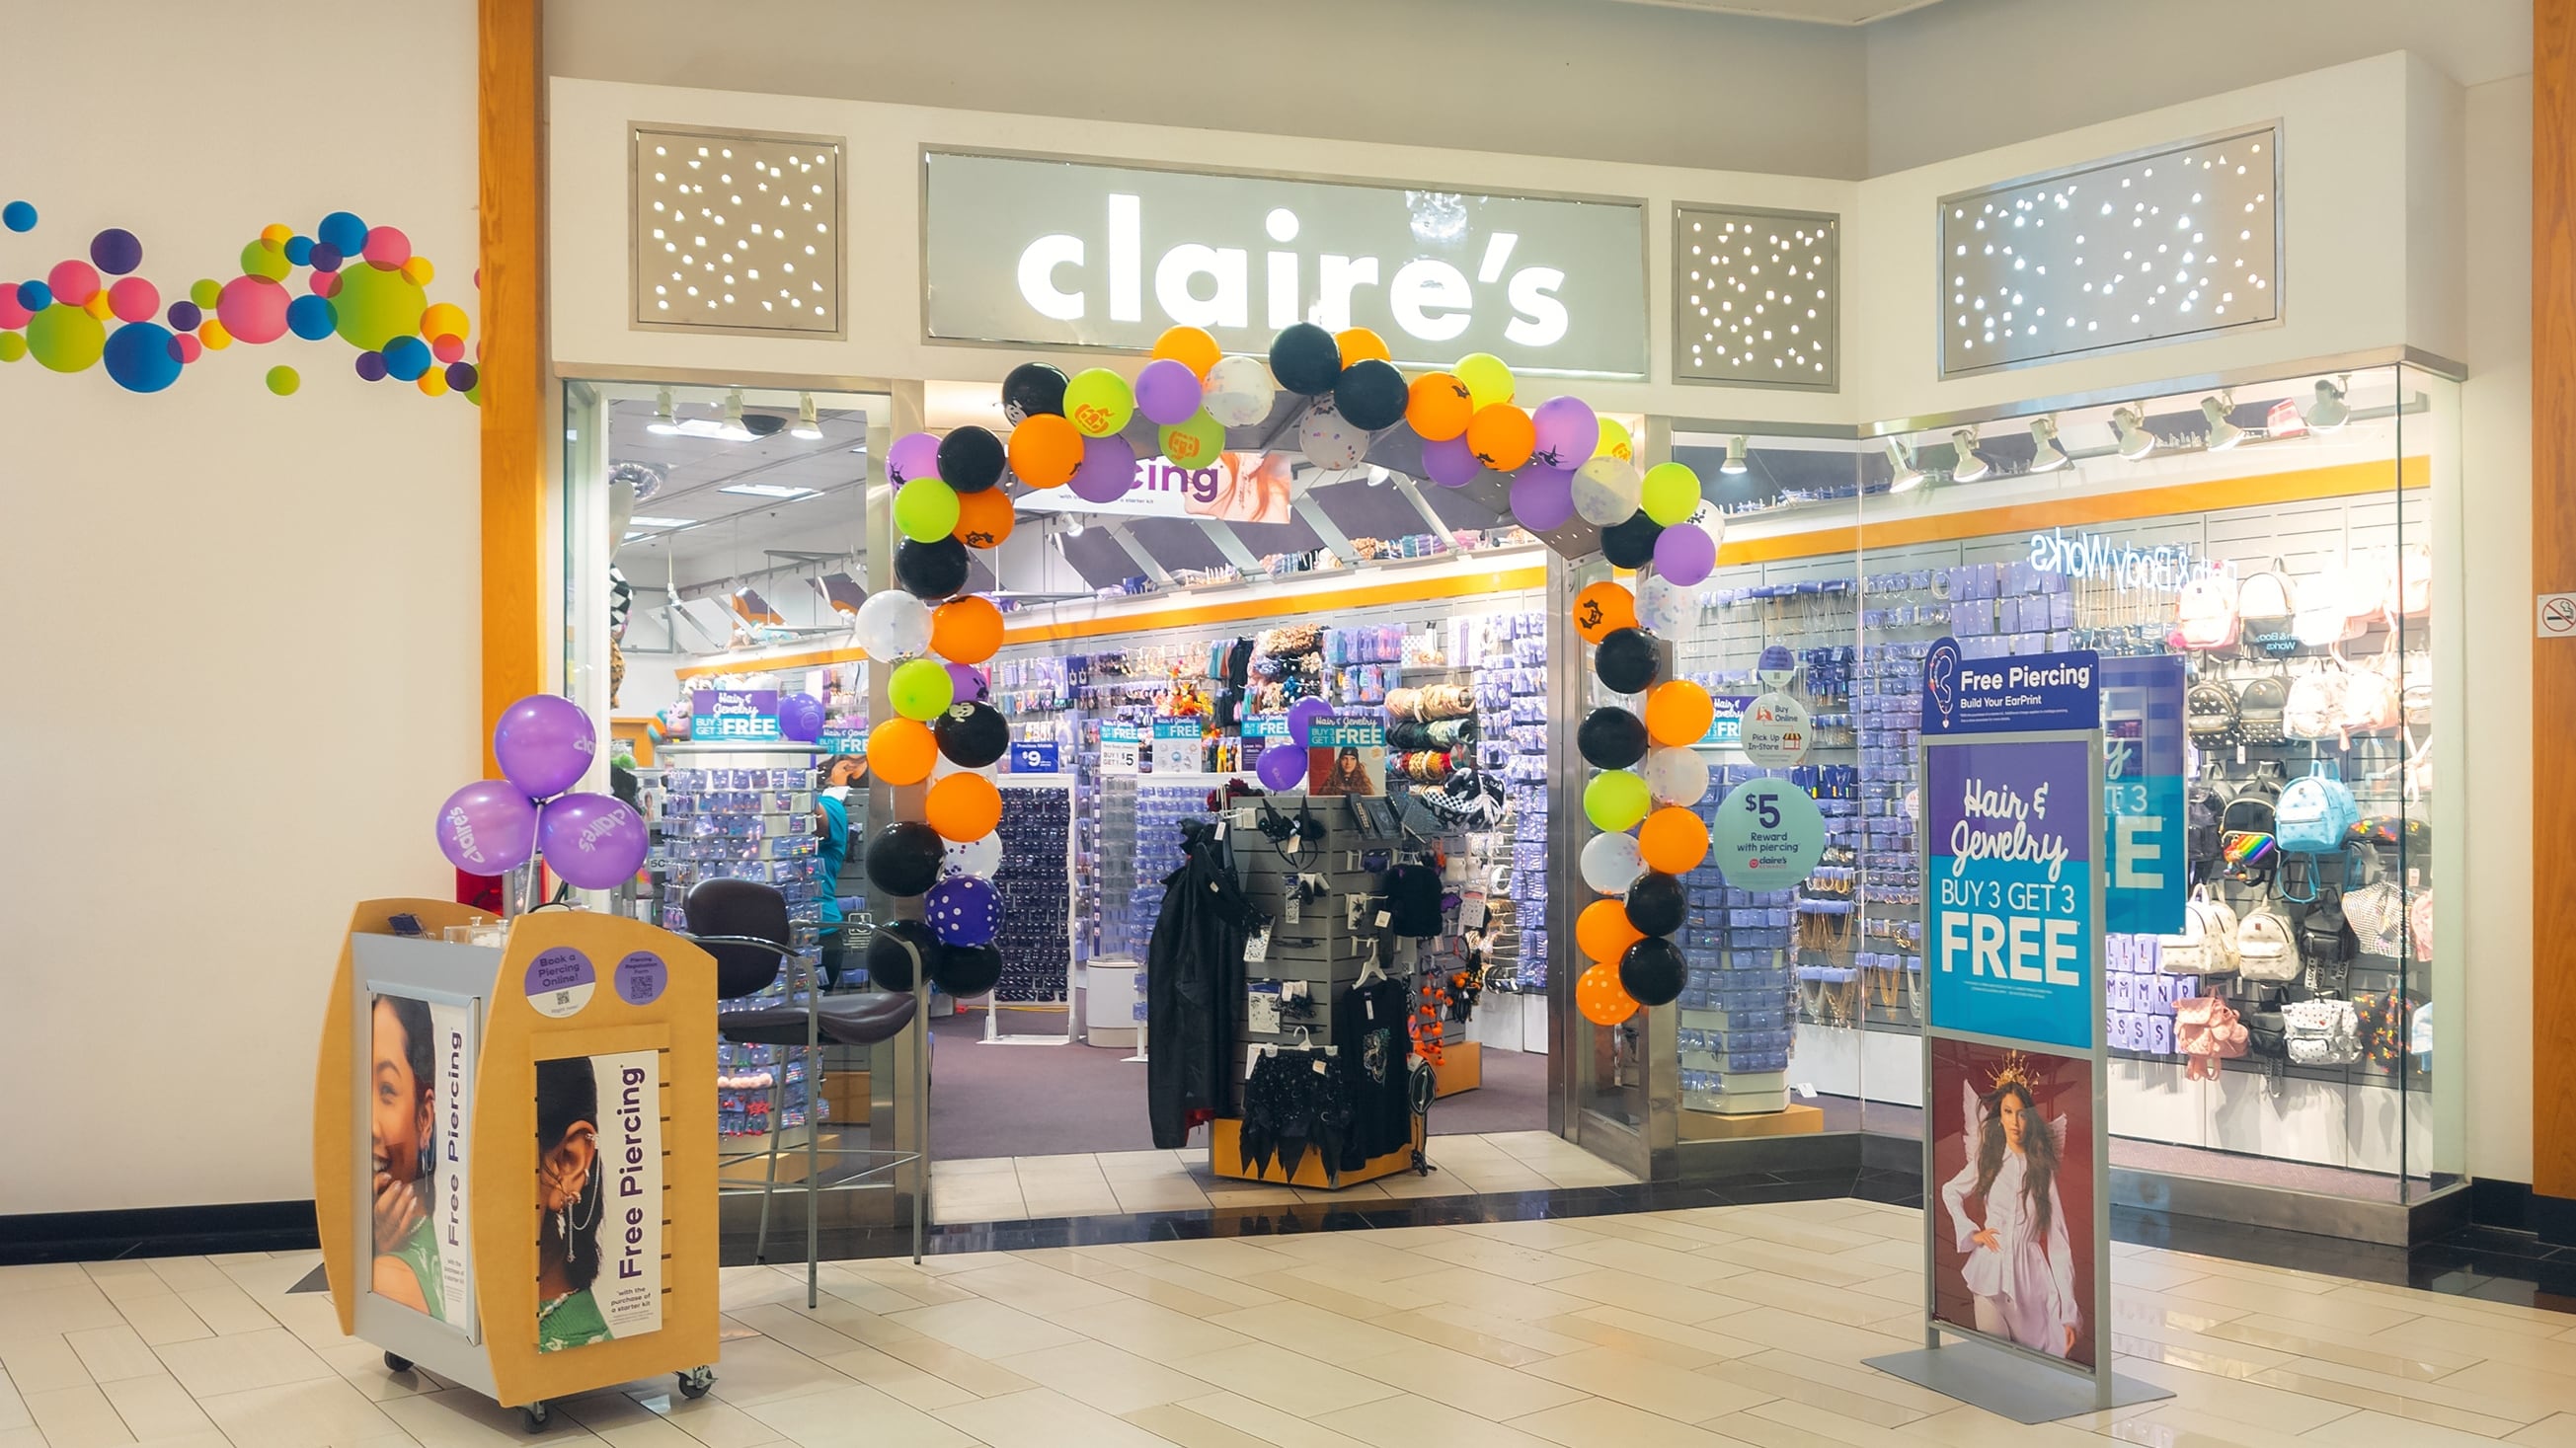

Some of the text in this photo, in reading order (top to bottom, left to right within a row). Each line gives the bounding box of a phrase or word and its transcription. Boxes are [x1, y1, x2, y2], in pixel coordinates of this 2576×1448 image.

[1017, 193, 1570, 347] claire's
[1961, 663, 2090, 691] Free Piercing
[718, 693, 745, 704] Hair
[1714, 699, 1735, 710] Hair
[1960, 695, 2042, 709] Build Your EarPrint
[713, 703, 758, 718] Jewelry
[723, 719, 776, 734] FREE
[1170, 724, 1200, 736] FREE
[1315, 717, 1335, 725] Hair
[1343, 717, 1378, 730] Jewelry
[1114, 728, 1136, 738] FREE
[1335, 728, 1382, 744] FREE
[1022, 750, 1041, 767] $9
[1122, 752, 1133, 766] $5
[1964, 778, 2049, 821] Hair &
[1746, 794, 1781, 829] $5
[1751, 832, 1787, 841] Reward
[1737, 843, 1799, 853] with piercing
[1951, 819, 2069, 882] Jewelry
[1941, 878, 2075, 914] BUY 3 GET 3
[1941, 910, 2080, 987] FREE
[539, 955, 567, 966] Book
[538, 963, 581, 977] Piercing
[543, 973, 579, 987] Online!
[2158, 986, 2168, 1002] N
[2135, 1023, 2144, 1037] S
[2156, 1025, 2164, 1040] S
[448, 1031, 462, 1246] Free Piercing
[616, 1067, 645, 1197] Piercing
[619, 1207, 643, 1279] Free
[611, 1295, 642, 1307] purchase
